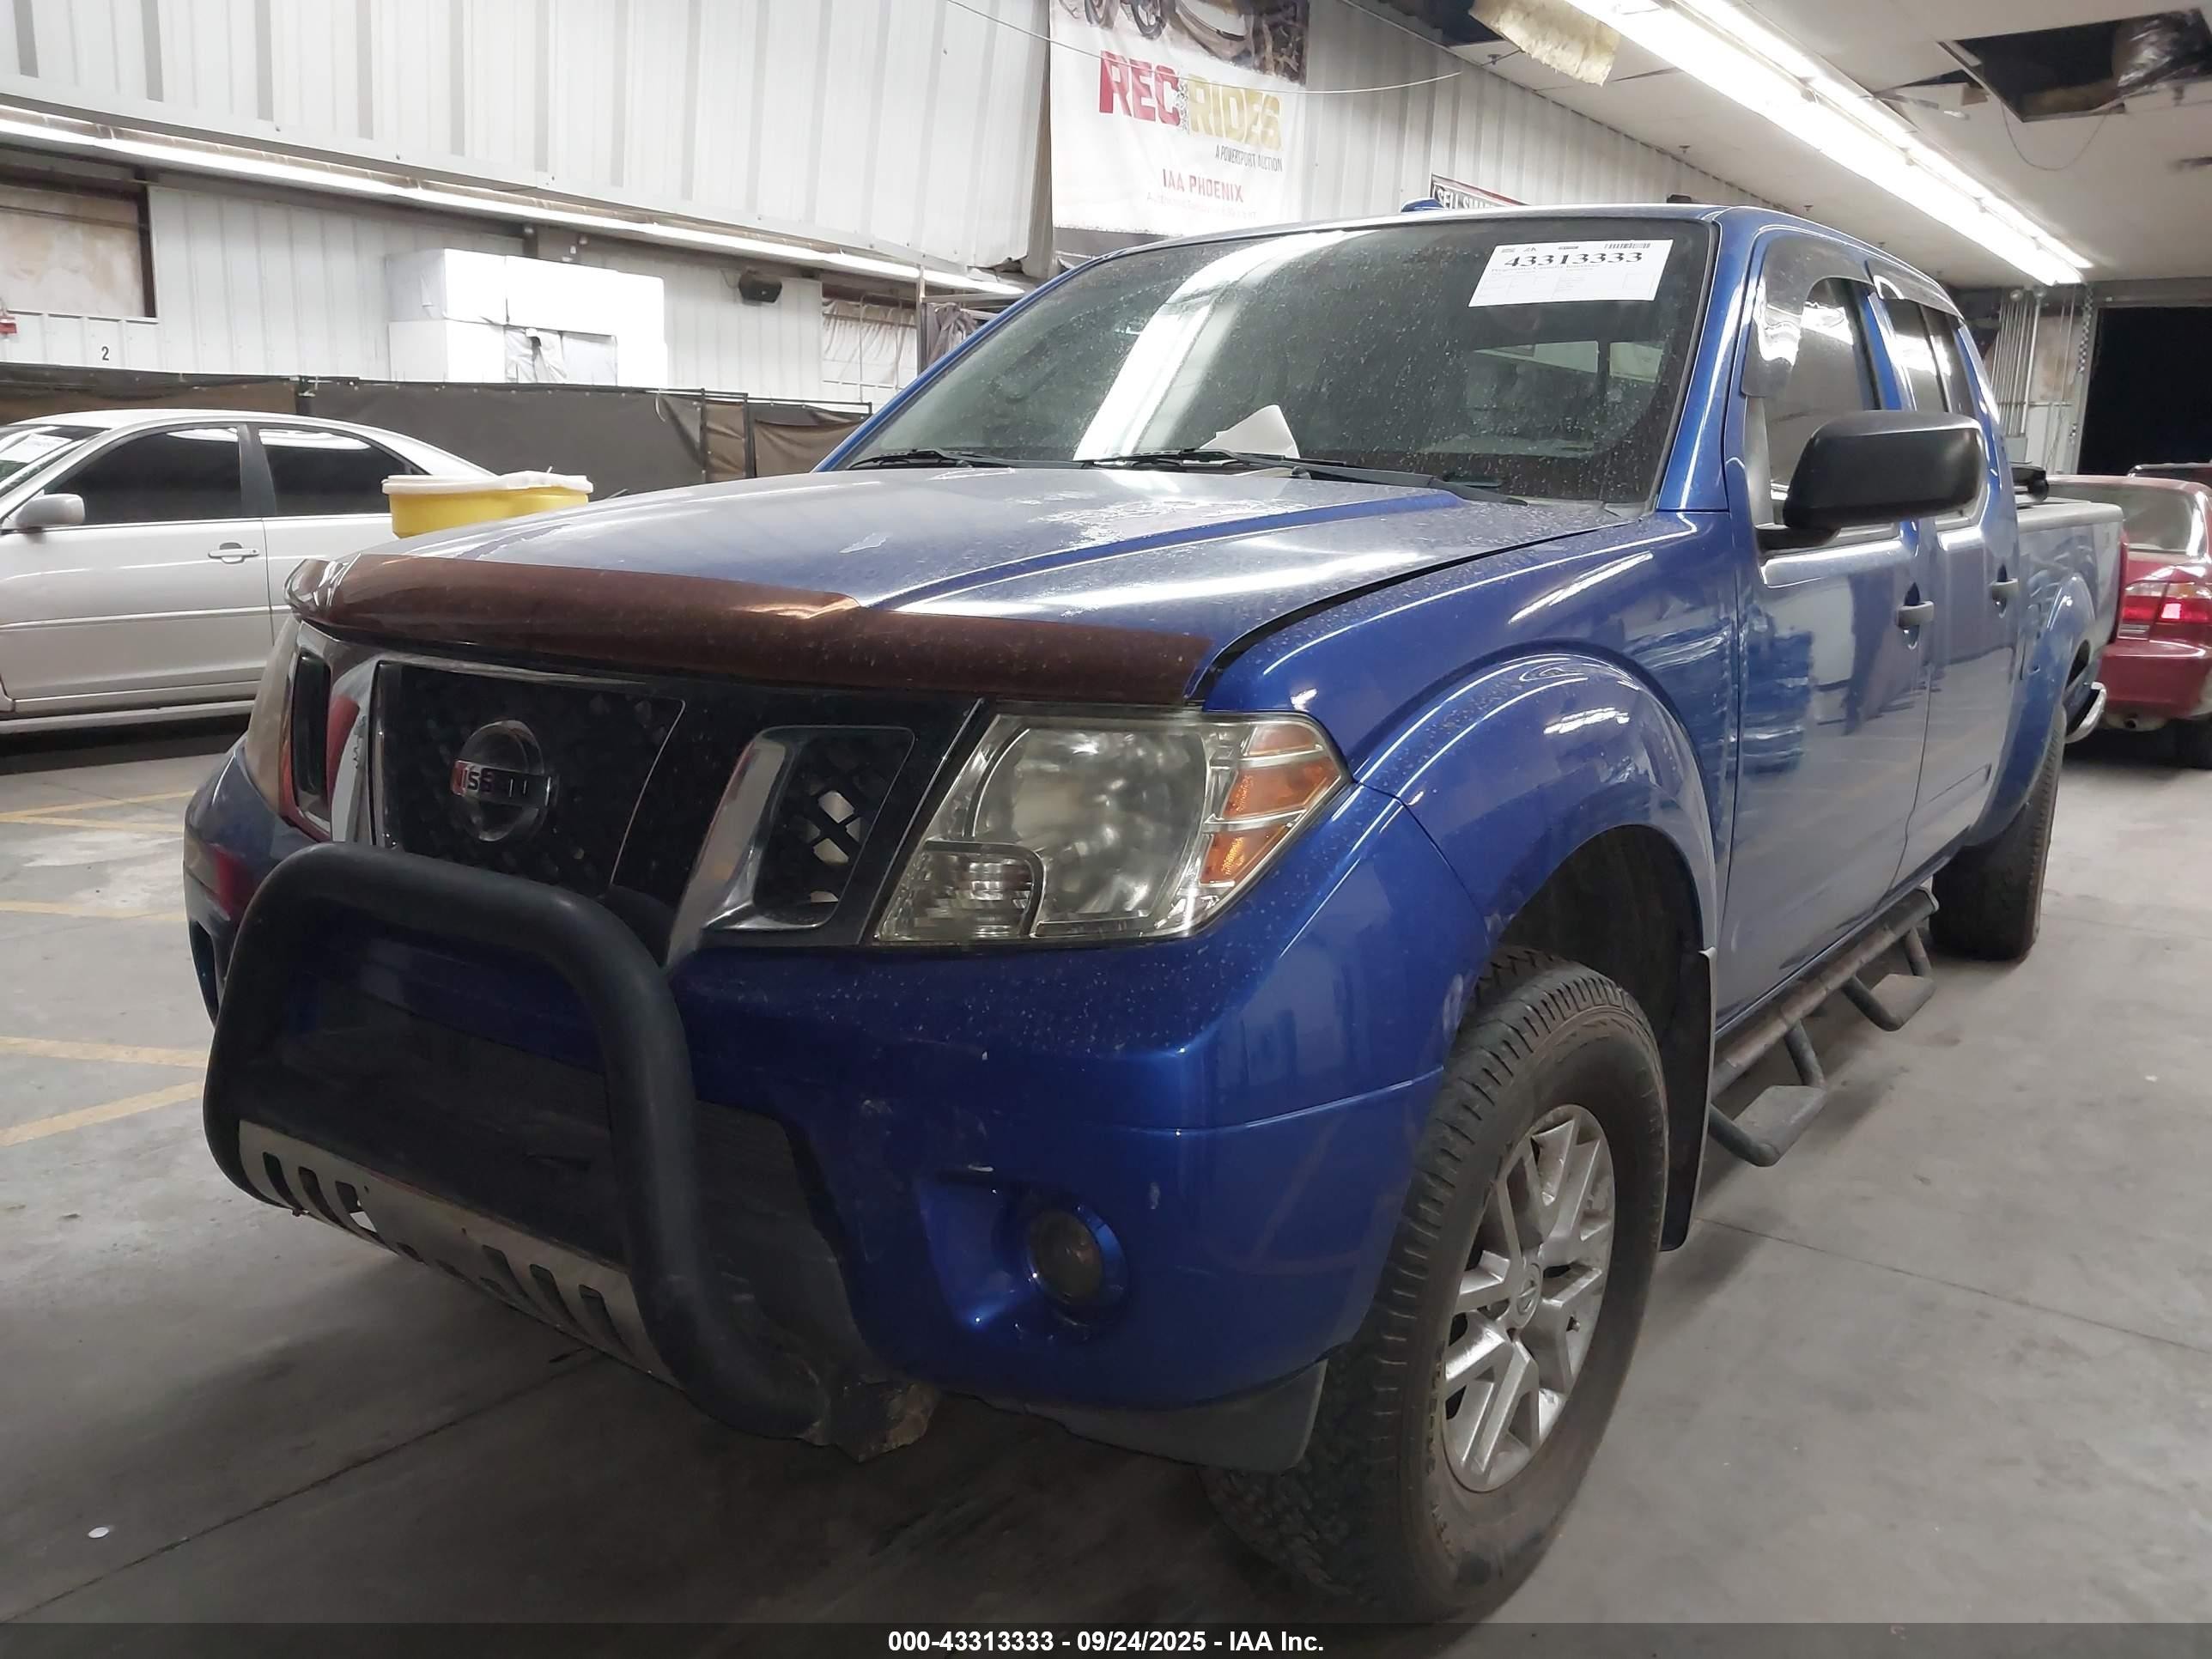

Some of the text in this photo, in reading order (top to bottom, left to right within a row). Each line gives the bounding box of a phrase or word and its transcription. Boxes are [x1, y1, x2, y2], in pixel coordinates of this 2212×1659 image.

[1099, 50, 1284, 152] REC RIDES
[1215, 144, 1220, 160] A
[1163, 168, 1244, 203] IAA PHOENIX
[1504, 252, 1643, 267] 43313333
[101, 345, 110, 362] 2
